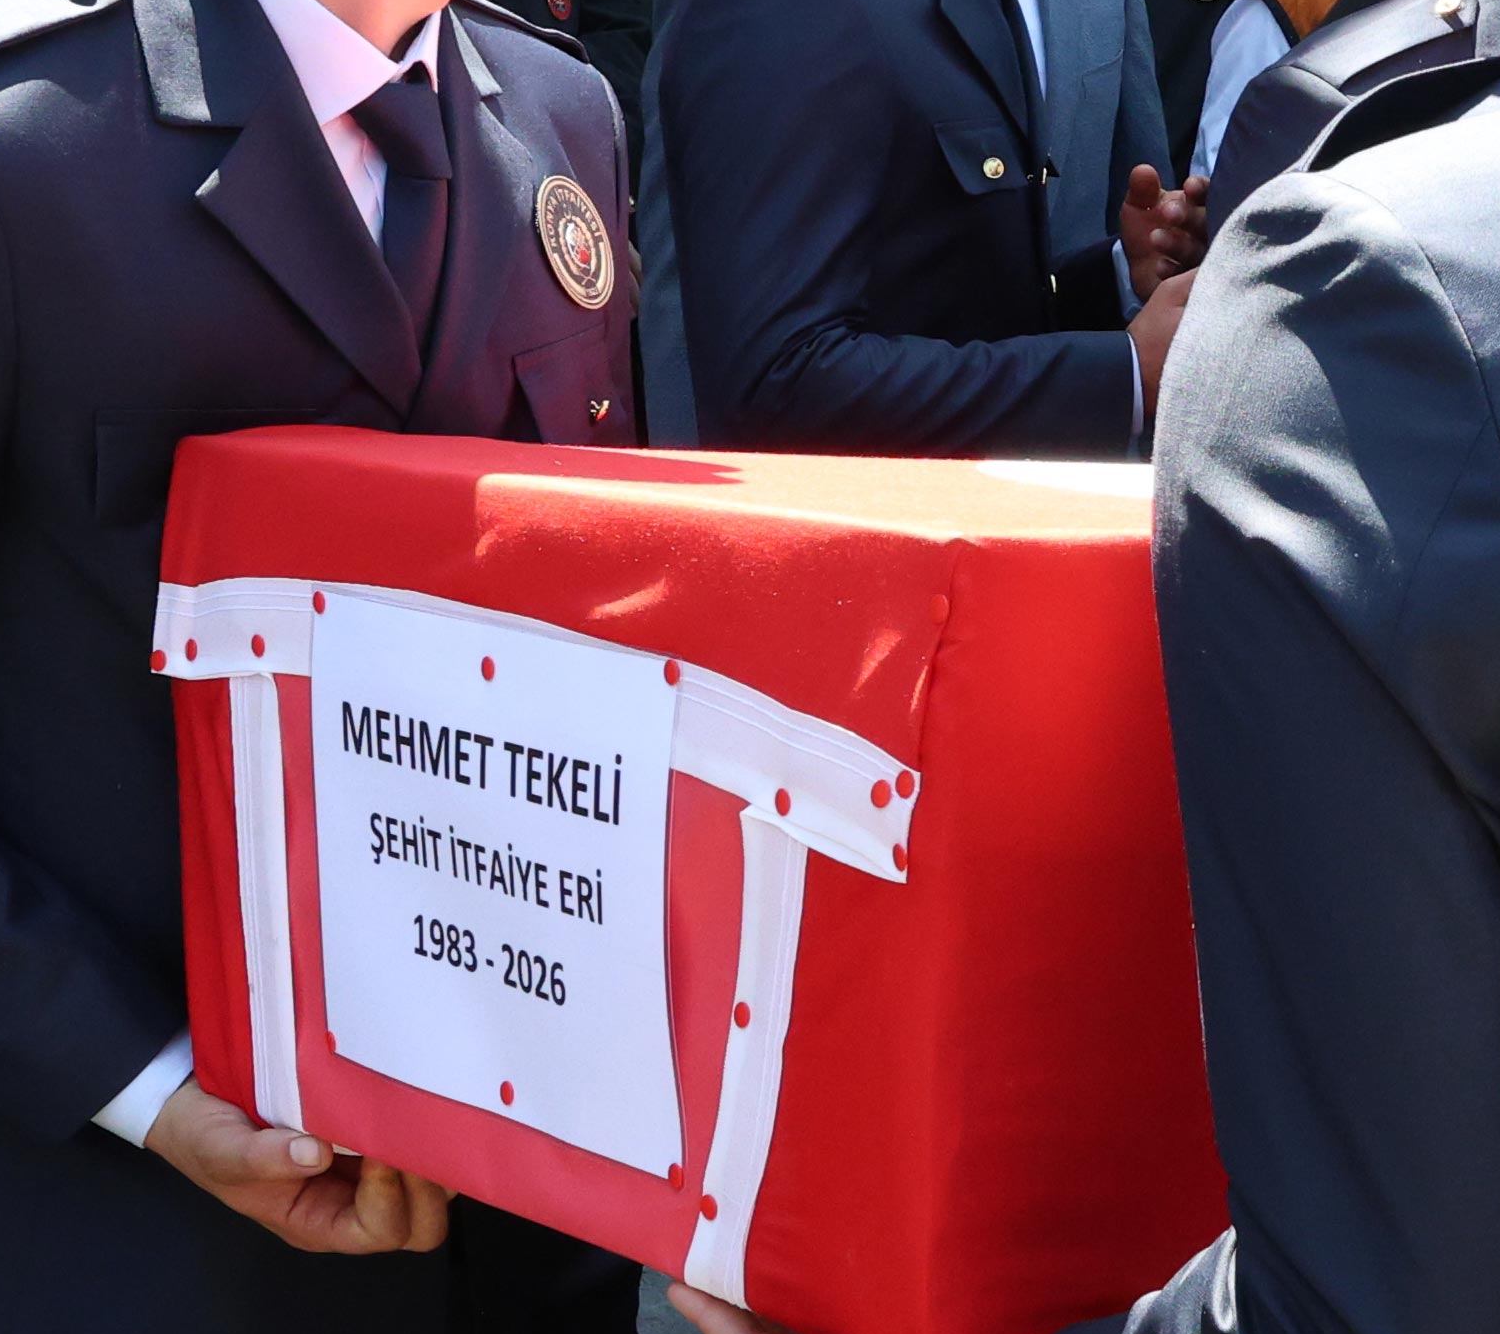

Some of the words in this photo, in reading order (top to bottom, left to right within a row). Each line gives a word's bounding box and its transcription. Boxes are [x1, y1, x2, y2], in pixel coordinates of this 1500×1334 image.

[342, 701, 495, 790] MEHMET
[503, 742, 623, 826] TEKELİ
[370, 812, 442, 873] ŞEHİT
[449, 825, 550, 909] İTFAİYE
[558, 868, 604, 926] ERİ
[413, 914, 478, 973] 1983
[485, 958, 495, 968] -
[502, 943, 566, 1007] 2026
